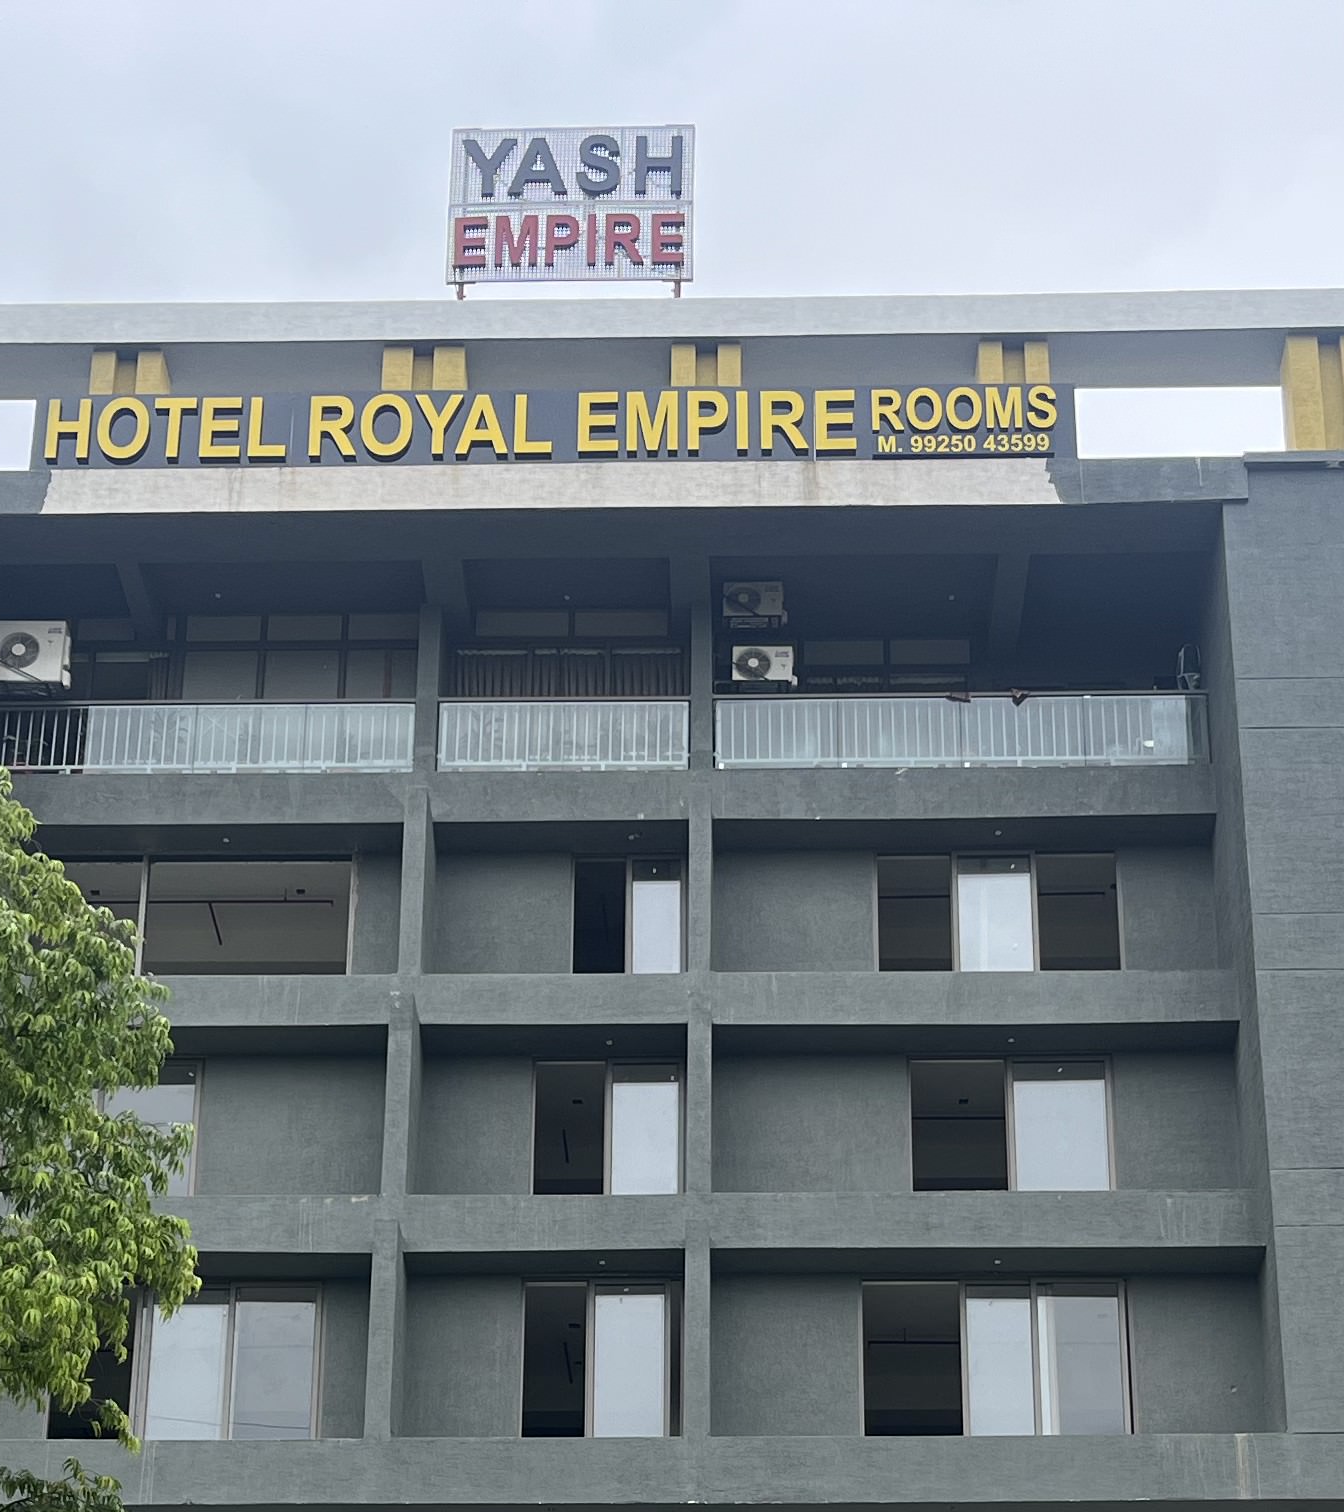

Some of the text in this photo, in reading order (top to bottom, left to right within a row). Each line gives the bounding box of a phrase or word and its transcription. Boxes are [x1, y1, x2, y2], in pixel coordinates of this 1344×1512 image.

[462, 134, 684, 197] YASH
[453, 213, 685, 267] EMPIRE
[43, 389, 857, 463] HOTEL ROYAL EMPIRE
[871, 385, 1057, 432] ROOMS
[878, 433, 1050, 453] M. 99250 43599
